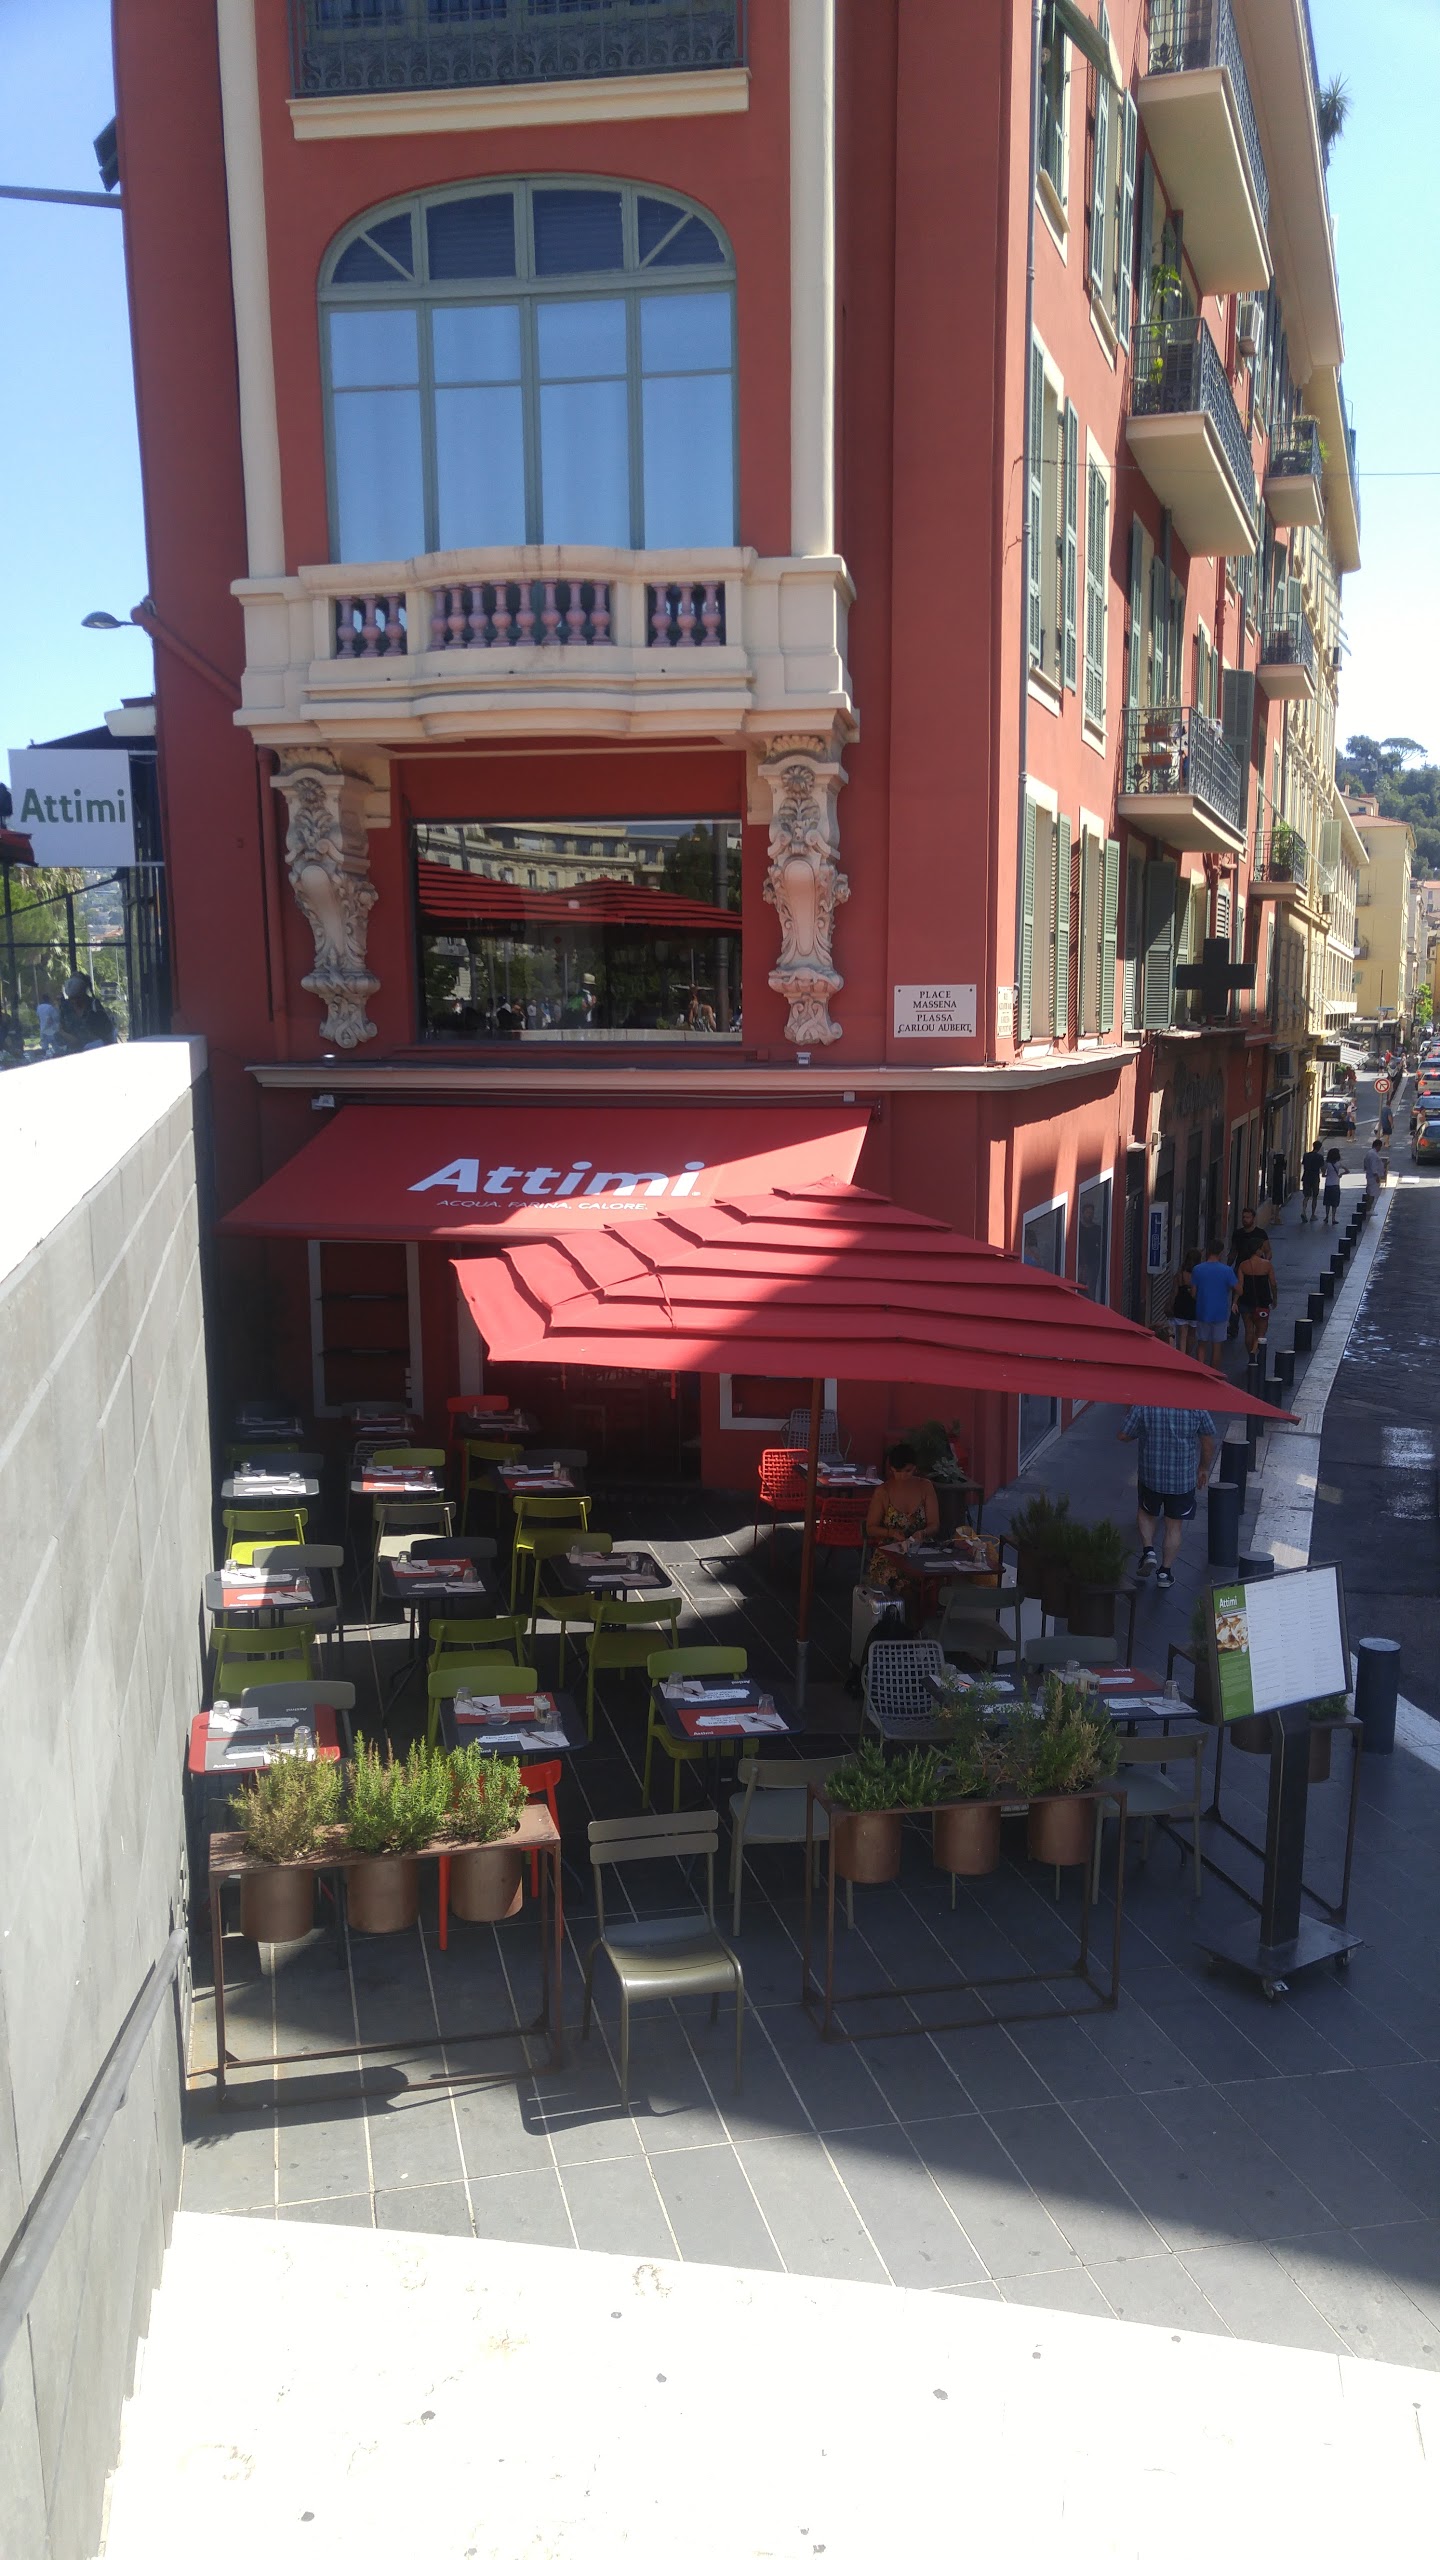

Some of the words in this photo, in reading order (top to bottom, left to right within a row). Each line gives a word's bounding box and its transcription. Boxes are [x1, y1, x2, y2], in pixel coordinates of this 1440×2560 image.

[20, 788, 126, 823] Attimi
[919, 990, 952, 999] PLACE
[912, 1000, 957, 1009] MASSENA
[916, 1013, 954, 1022] PLASSA
[898, 1023, 936, 1033] CARLOU
[937, 1023, 972, 1032] AUBERT
[406, 1157, 705, 1198] Attimi
[436, 1200, 502, 1208] ACQUA.
[507, 1201, 572, 1210] FARINA.
[577, 1202, 648, 1210] CALORE.
[1219, 1594, 1238, 1609] Attimi
